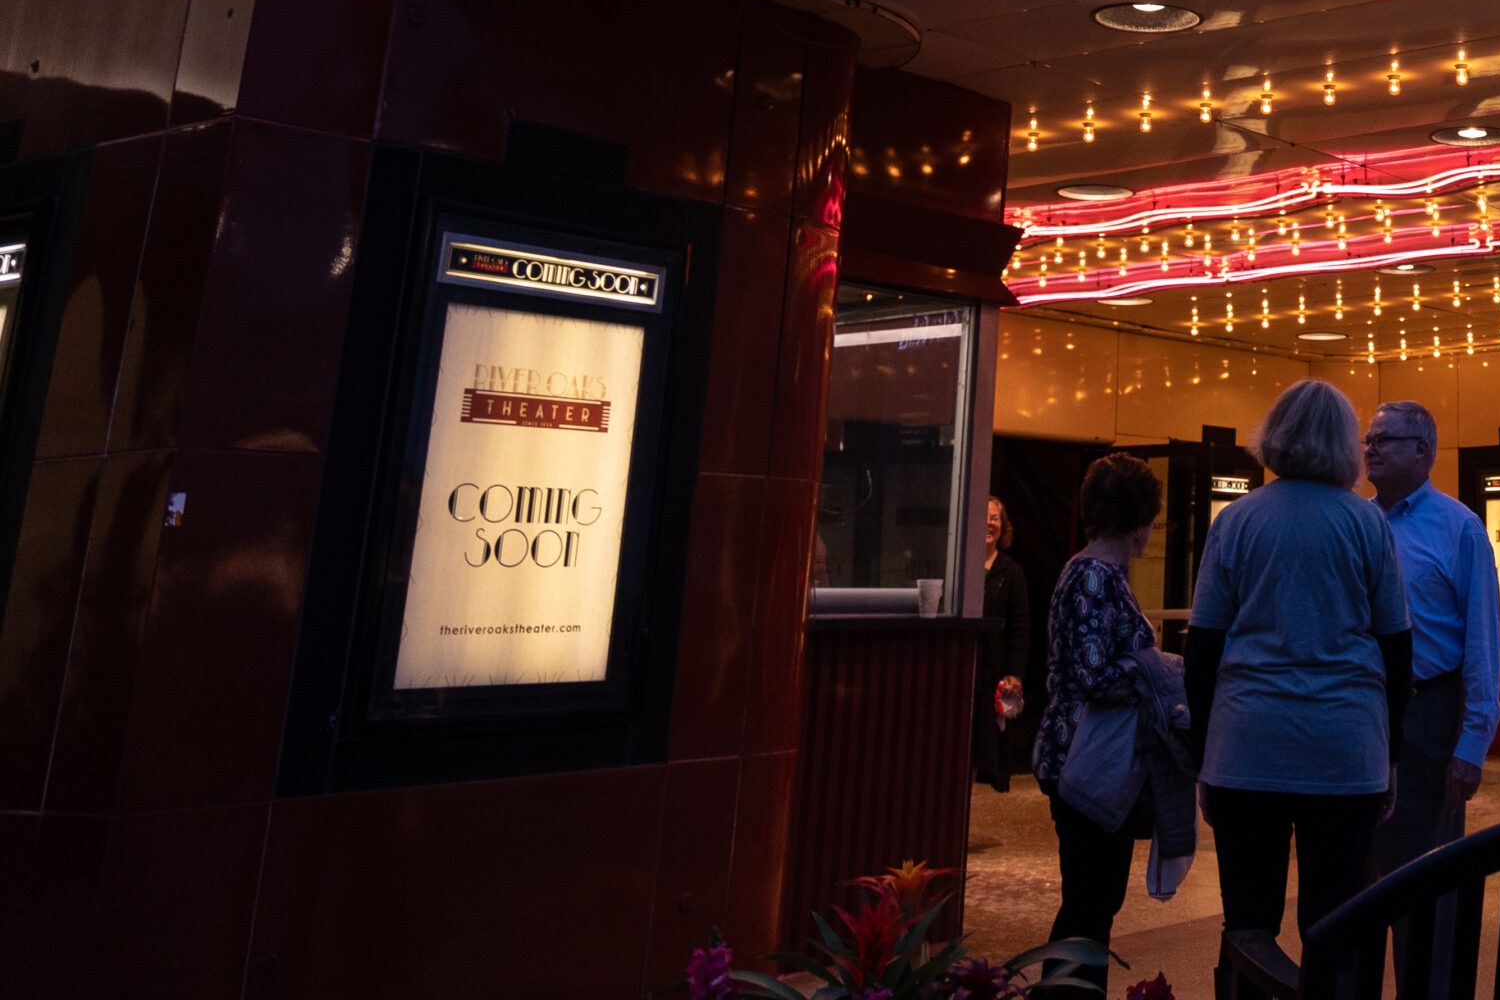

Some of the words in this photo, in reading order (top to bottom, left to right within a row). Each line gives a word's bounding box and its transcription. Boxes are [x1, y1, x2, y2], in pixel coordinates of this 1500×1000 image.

[511, 259, 586, 287] COMING
[587, 271, 639, 295] SOON
[474, 364, 541, 394] RIVER
[547, 372, 607, 400] OAKS
[487, 399, 590, 422] THEATER
[448, 482, 602, 526] COMING
[464, 527, 580, 568] SOON
[440, 623, 581, 637] theriveroakstheater.com
